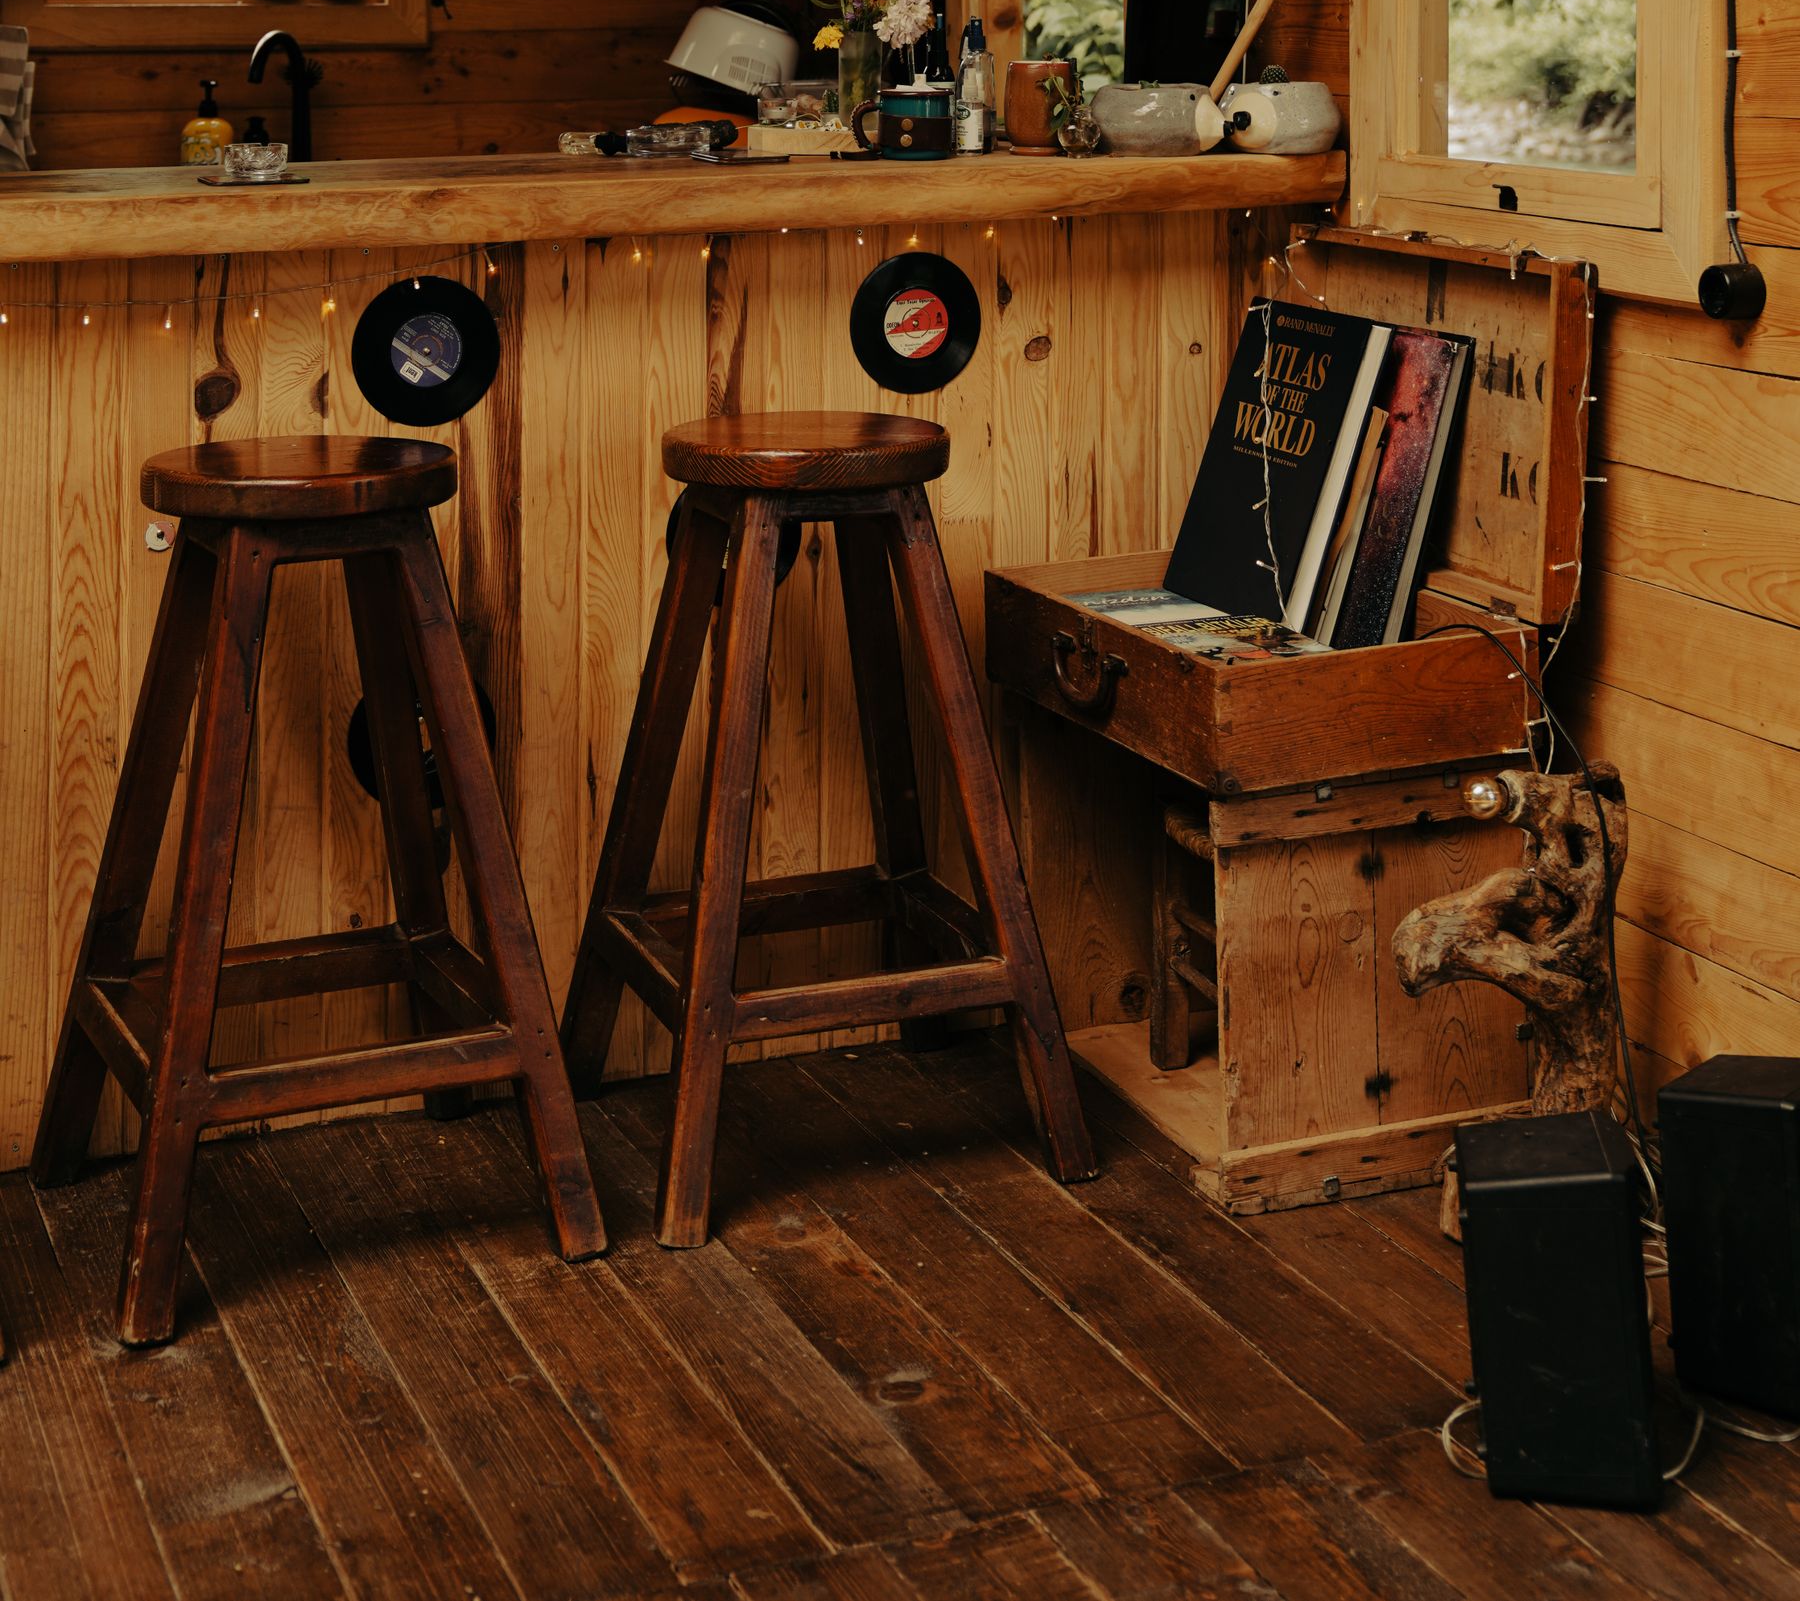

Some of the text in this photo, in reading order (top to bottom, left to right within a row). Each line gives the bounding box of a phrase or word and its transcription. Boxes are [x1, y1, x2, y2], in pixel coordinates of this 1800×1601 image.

[1284, 316, 1305, 331] RAND
[1256, 342, 1332, 391] ATLAS
[1262, 383, 1309, 414] OF THE
[1234, 401, 1316, 457] WORLD
[1233, 445, 1298, 469] MILLENNIM EDITION
